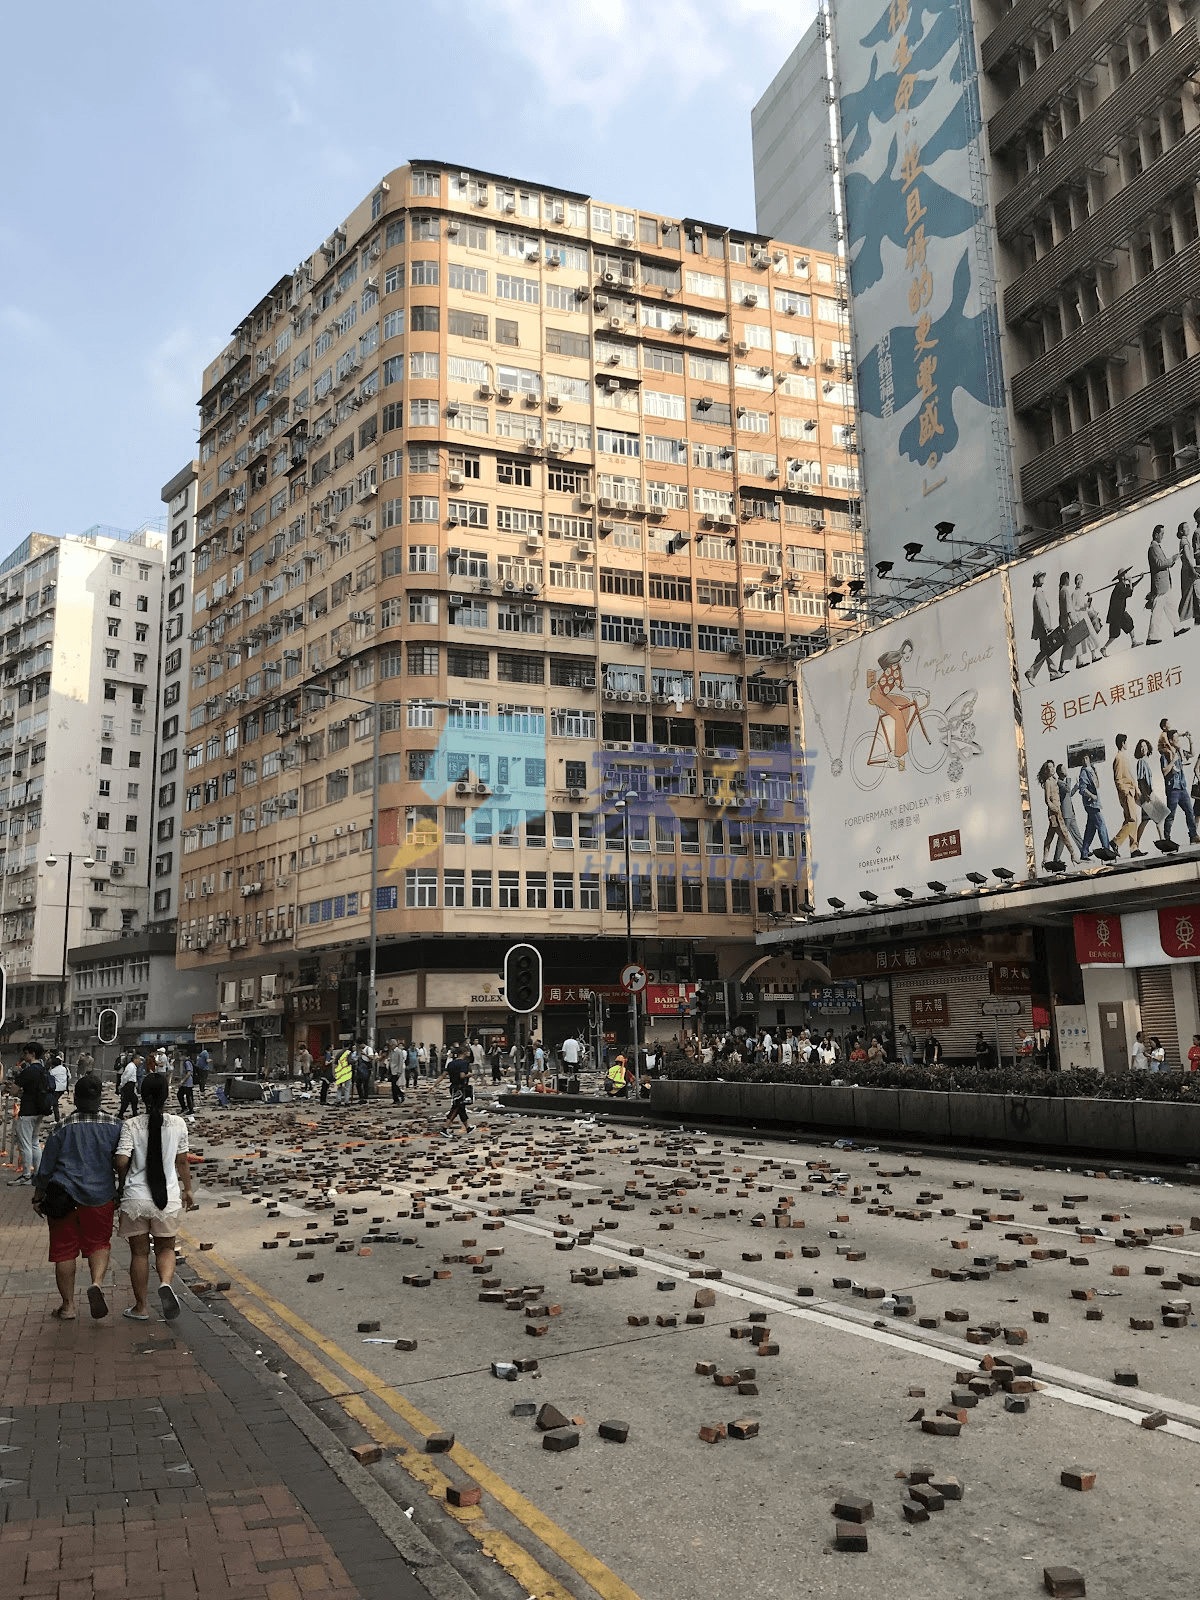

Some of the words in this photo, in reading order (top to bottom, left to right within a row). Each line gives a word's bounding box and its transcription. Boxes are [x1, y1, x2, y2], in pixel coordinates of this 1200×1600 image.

[934, 661, 957, 681] Free
[960, 645, 994, 672] Spirit
[1063, 691, 1107, 719] BEA
[1109, 665, 1182, 705] 東亞銀行
[933, 835, 957, 848] 周大福
[858, 854, 900, 868] FOREVERMARK
[877, 948, 916, 968] 周大福
[471, 995, 503, 1003] ROLEX
[550, 988, 590, 1001] 周大福
[915, 998, 942, 1012] 周大福
